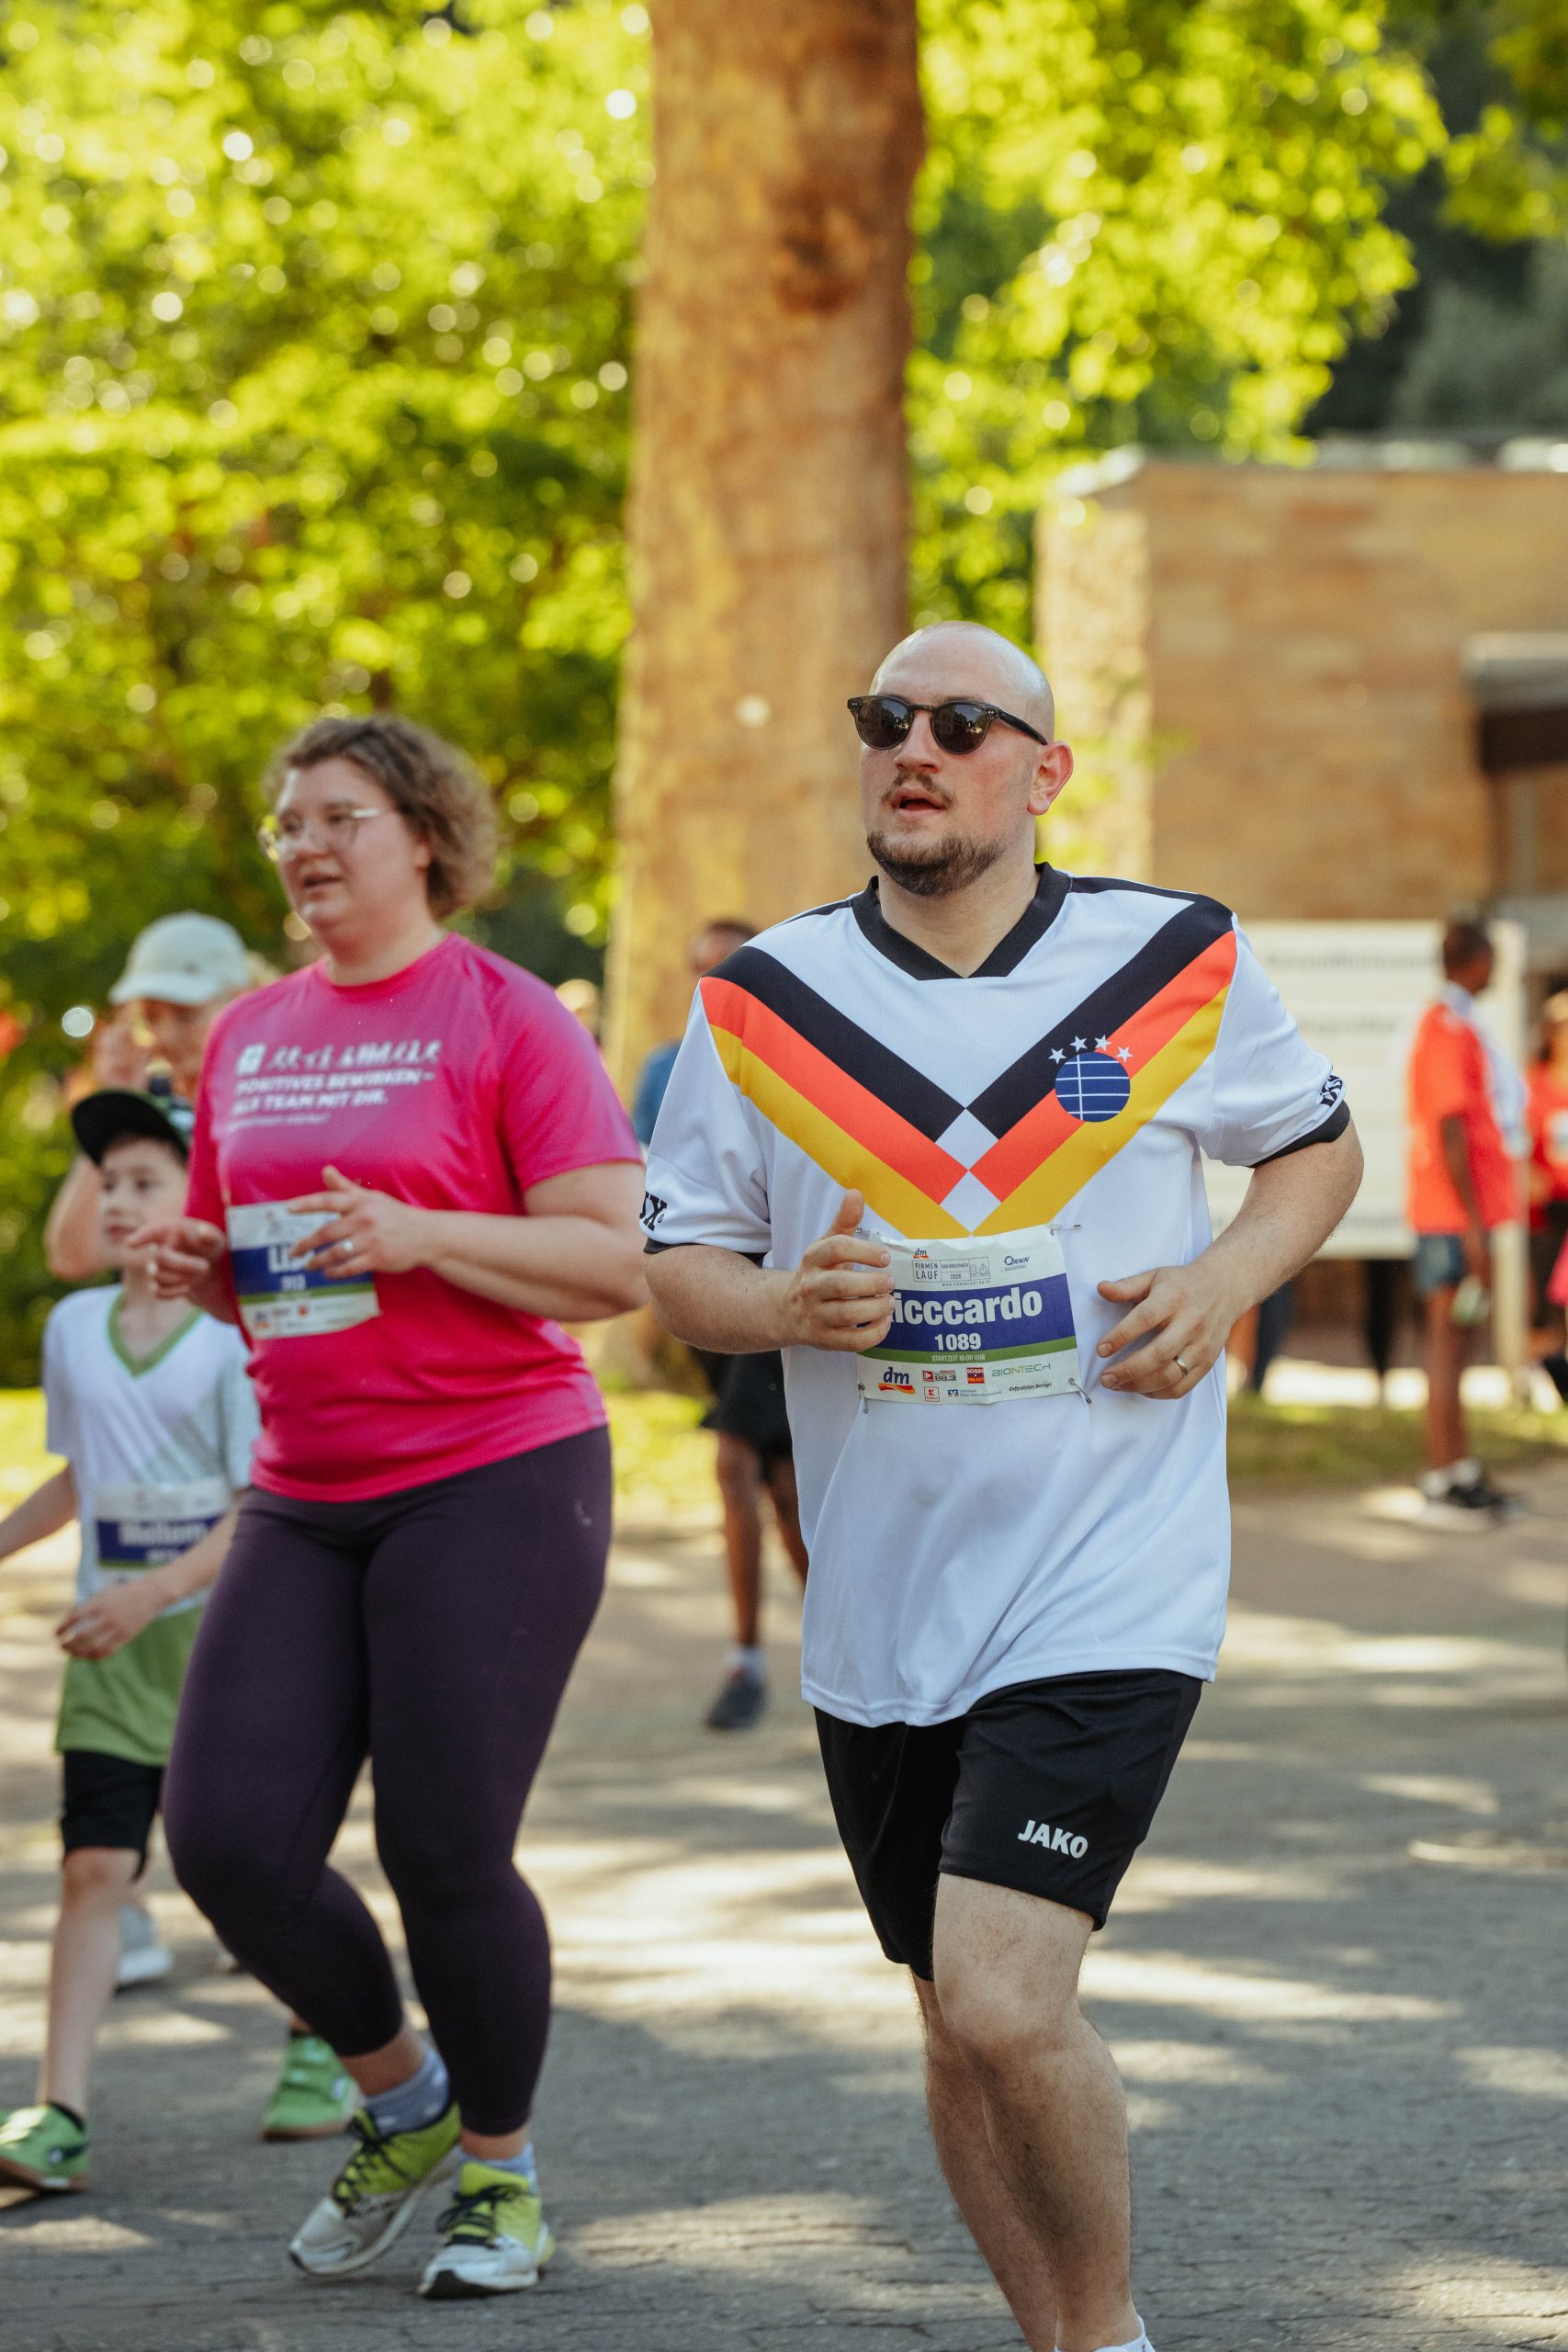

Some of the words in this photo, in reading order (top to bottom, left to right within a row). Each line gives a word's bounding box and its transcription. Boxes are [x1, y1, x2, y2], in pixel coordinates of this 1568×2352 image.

[915, 1248, 927, 1256] dm
[915, 1271, 939, 1280] LAUF
[891, 1286, 1043, 1326] icccardo
[934, 1332, 982, 1351] 1089
[883, 1367, 910, 1385] dm
[992, 1362, 1051, 1377] BIONTECH
[1017, 1819, 1089, 1859] JAKO
